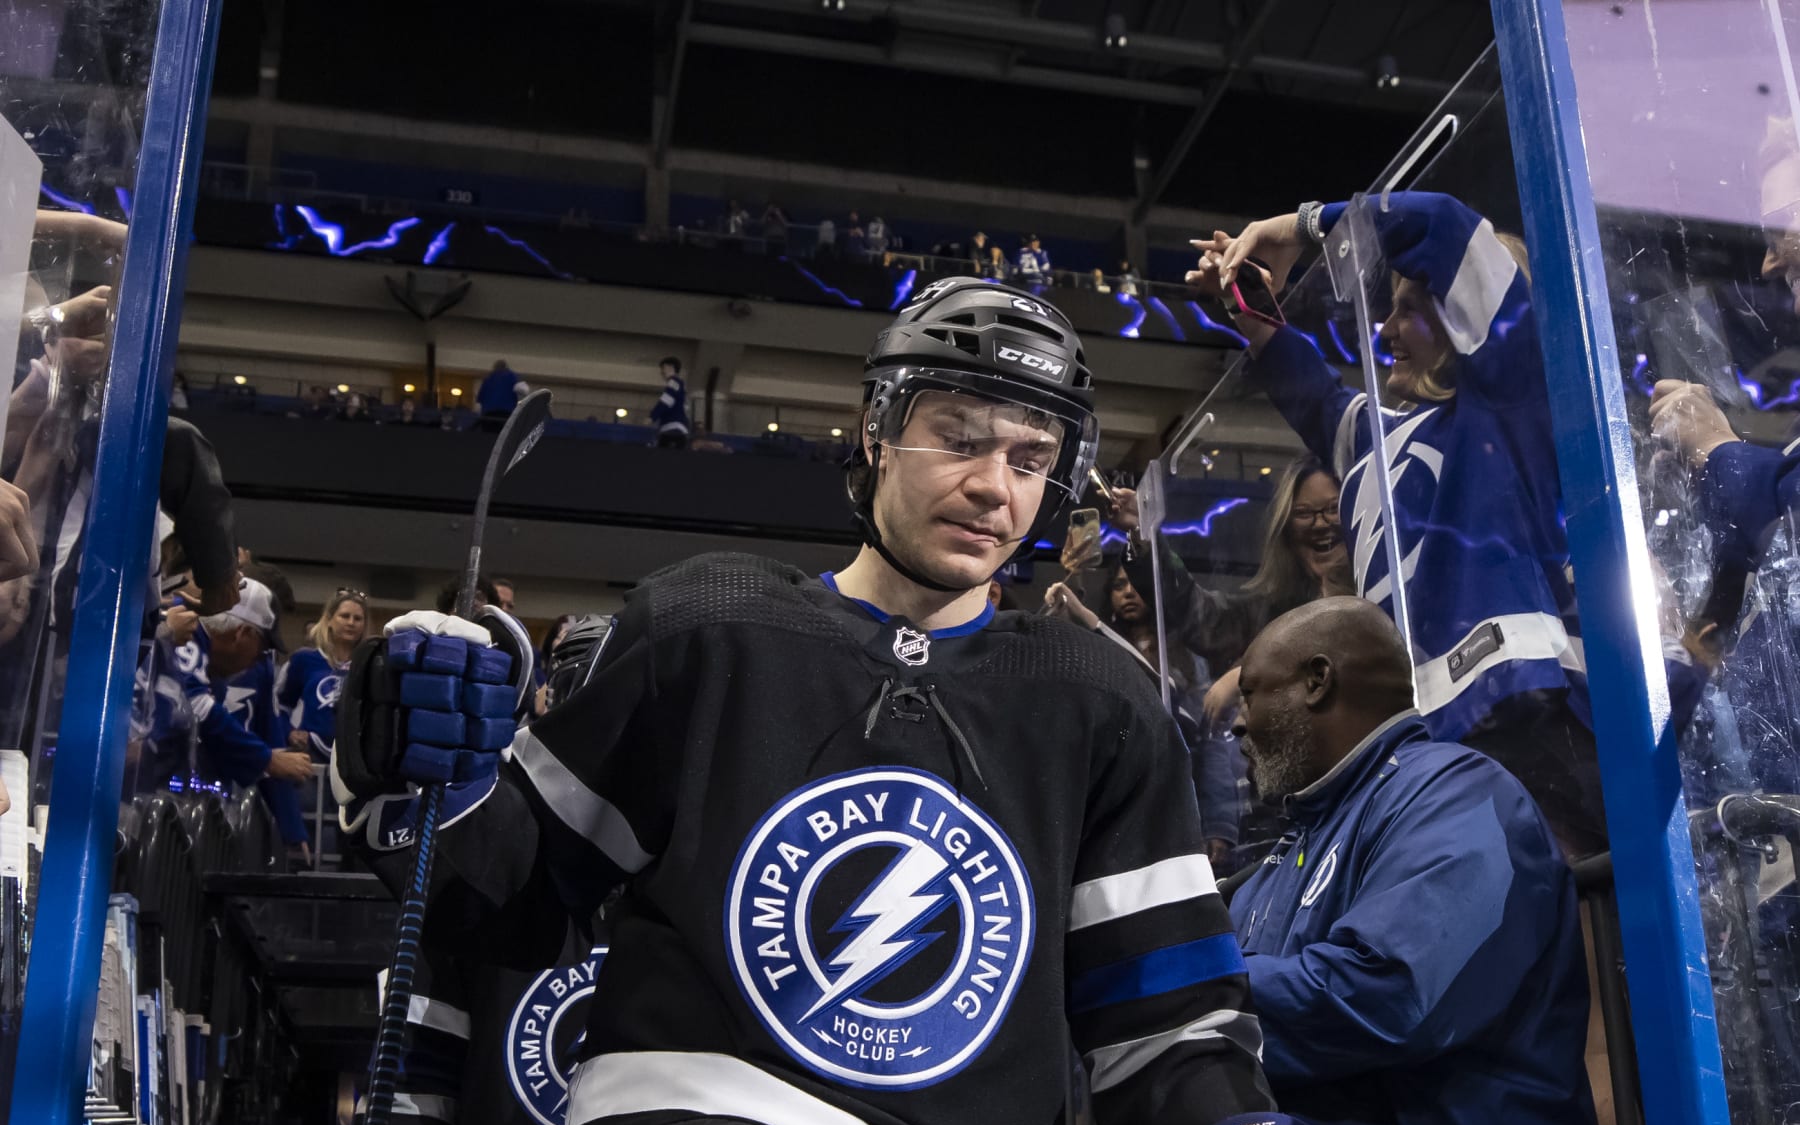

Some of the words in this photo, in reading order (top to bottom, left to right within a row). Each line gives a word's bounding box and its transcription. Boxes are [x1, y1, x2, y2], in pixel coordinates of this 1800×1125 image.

[997, 346, 1064, 376] CCM
[901, 641, 923, 655] NHL
[752, 840, 810, 992] TAMPA
[806, 791, 890, 843] BAY
[908, 797, 1012, 1021] LIGHTNING
[520, 1002, 553, 1097] TAMPA
[547, 960, 597, 1000] BAY
[834, 1015, 912, 1044] HOCKEY
[845, 1041, 896, 1061] CLUB
